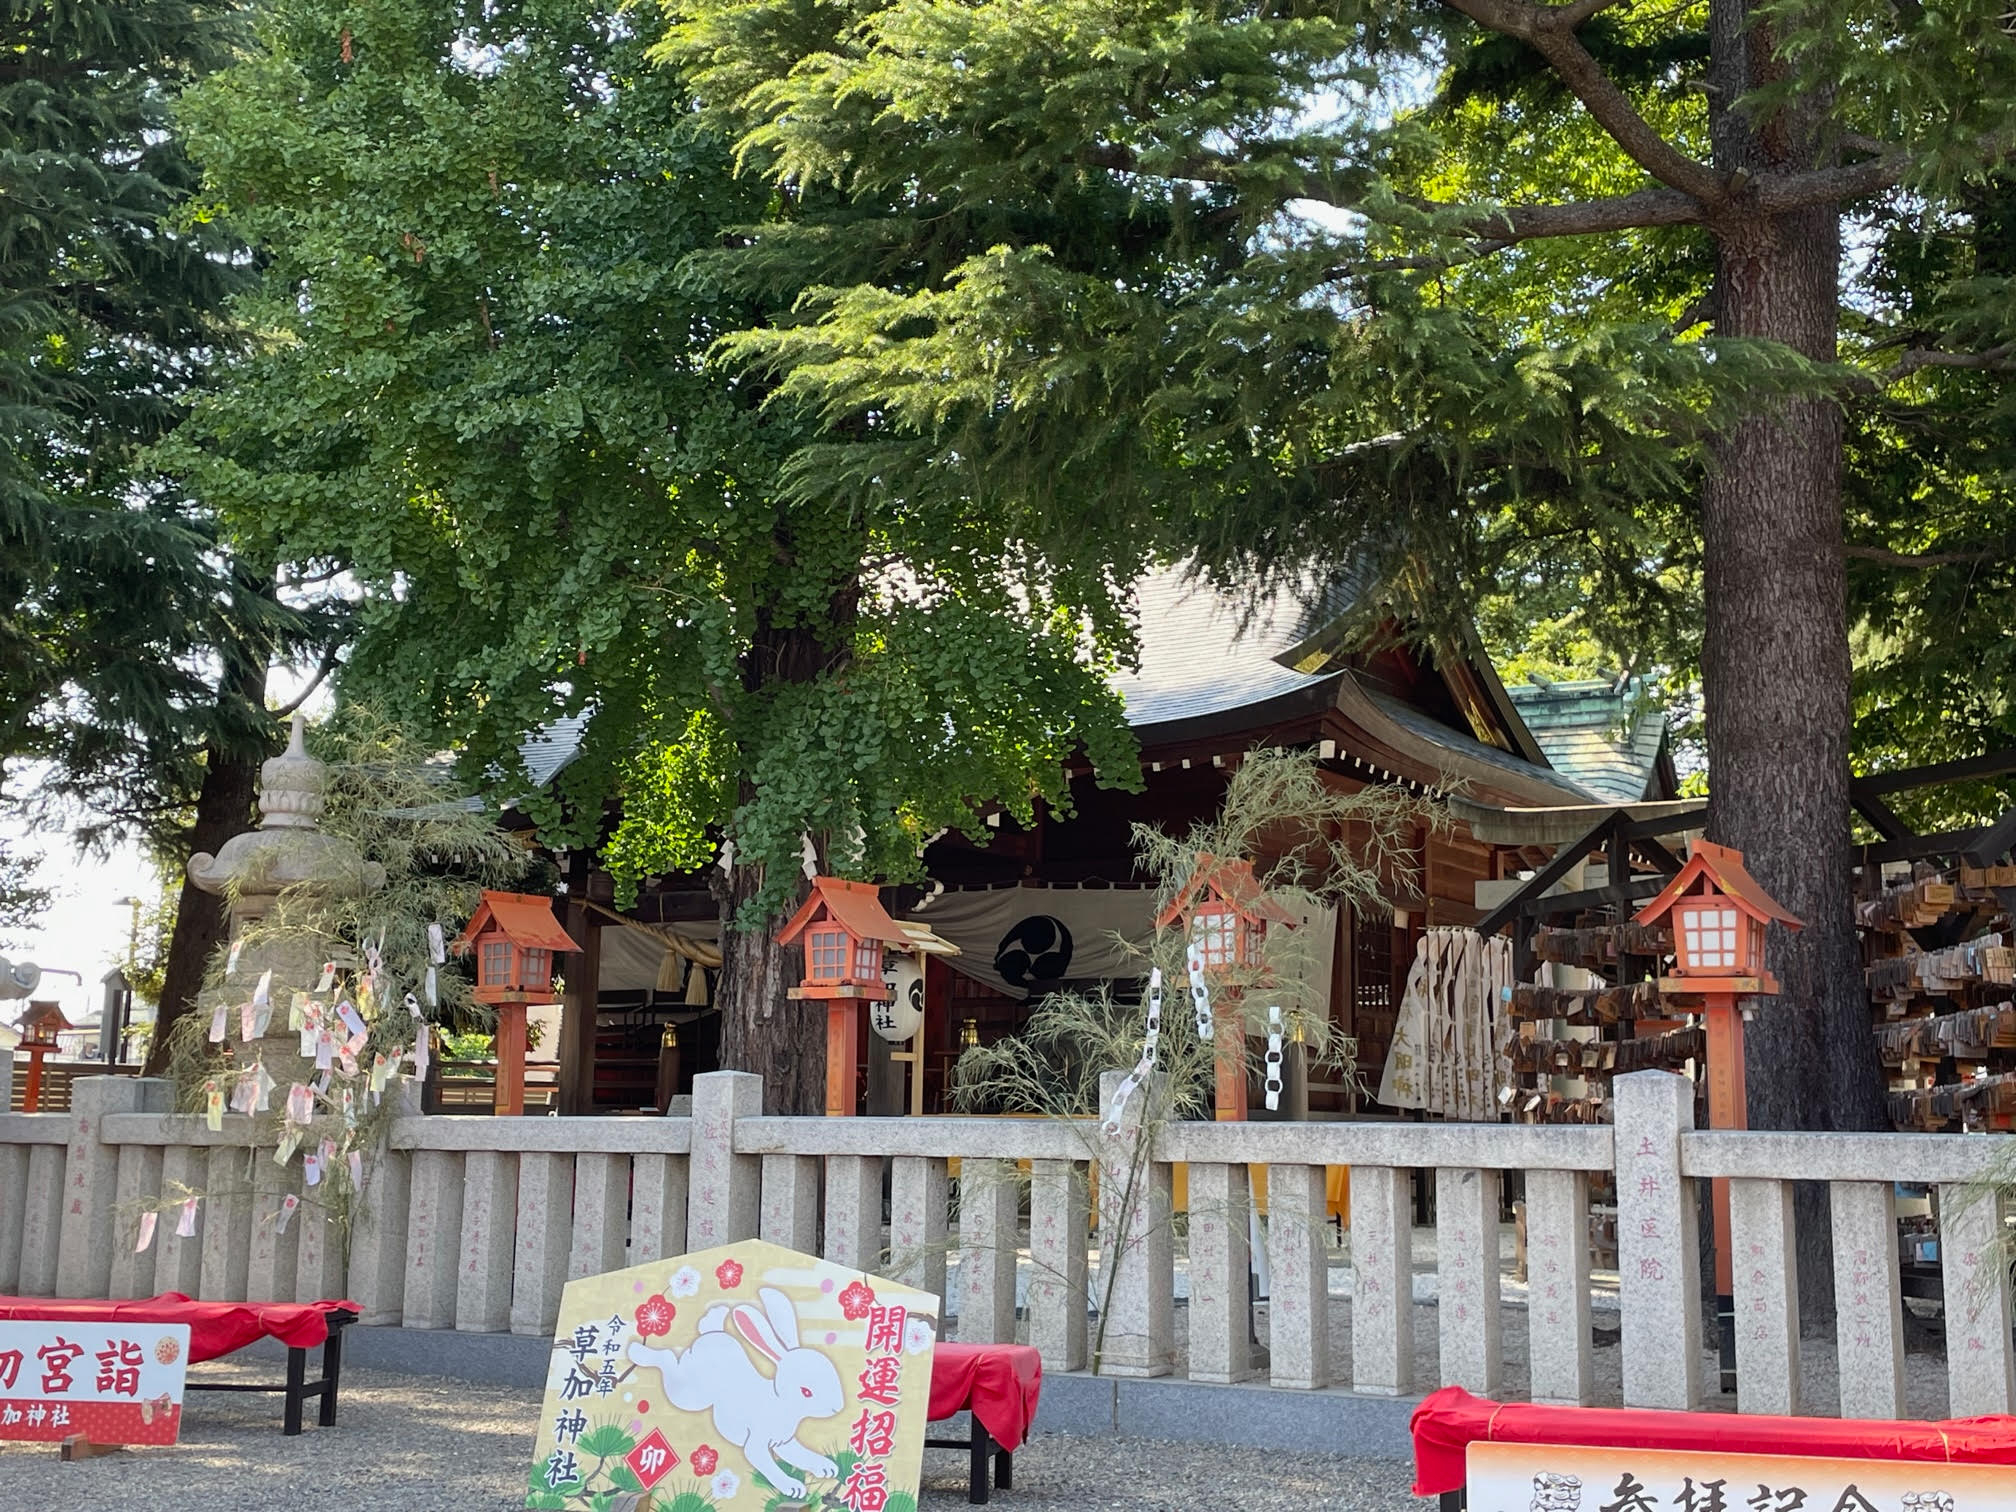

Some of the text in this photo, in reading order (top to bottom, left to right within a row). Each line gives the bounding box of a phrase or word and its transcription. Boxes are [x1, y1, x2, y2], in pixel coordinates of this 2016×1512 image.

[1636, 1136, 1664, 1281] 土井医院
[544, 1325, 600, 1487] 草加神社
[596, 1314, 626, 1399] 令和五年
[842, 1305, 907, 1512] 開運招福
[639, 1445, 667, 1475] 卯
